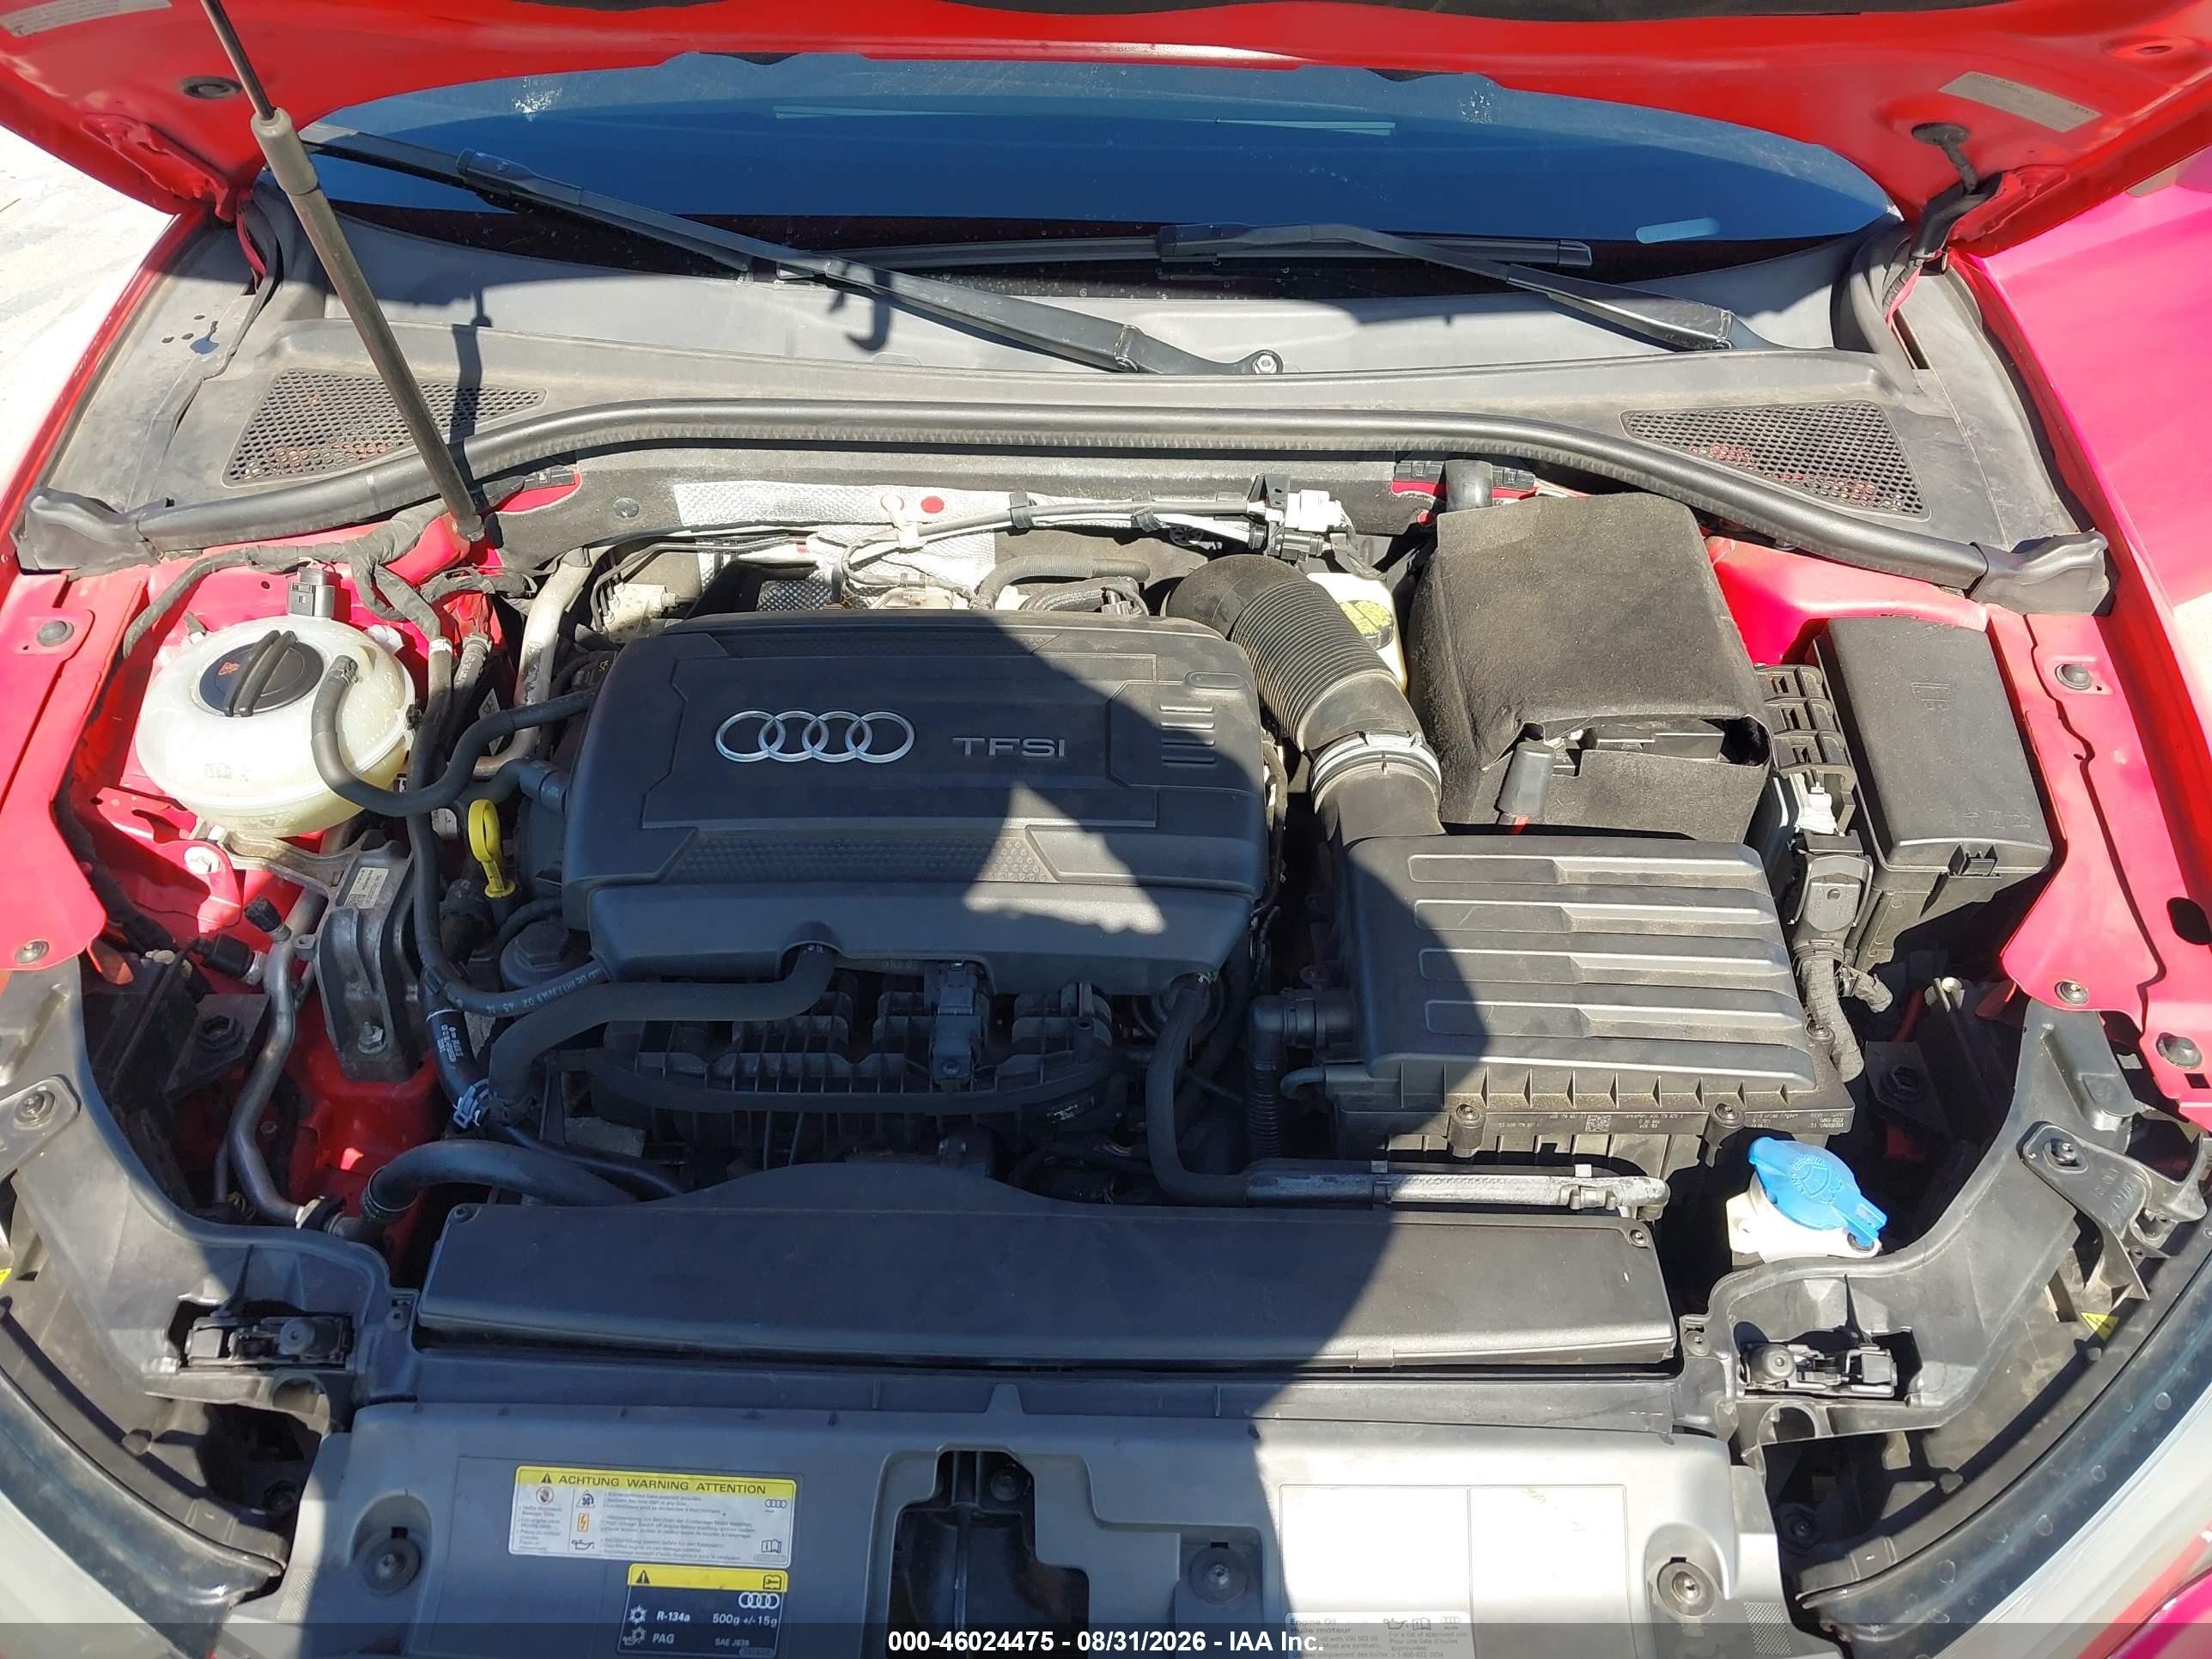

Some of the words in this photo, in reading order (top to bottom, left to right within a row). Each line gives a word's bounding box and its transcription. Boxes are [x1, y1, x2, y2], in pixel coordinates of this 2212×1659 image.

[952, 738, 1066, 757] TFSI
[558, 1474, 619, 1487] ACHTUNG
[627, 1478, 689, 1491] WARNING
[696, 1481, 767, 1495] ATTENTION
[656, 1611, 691, 1622] R-134a
[652, 1633, 675, 1645] PAG
